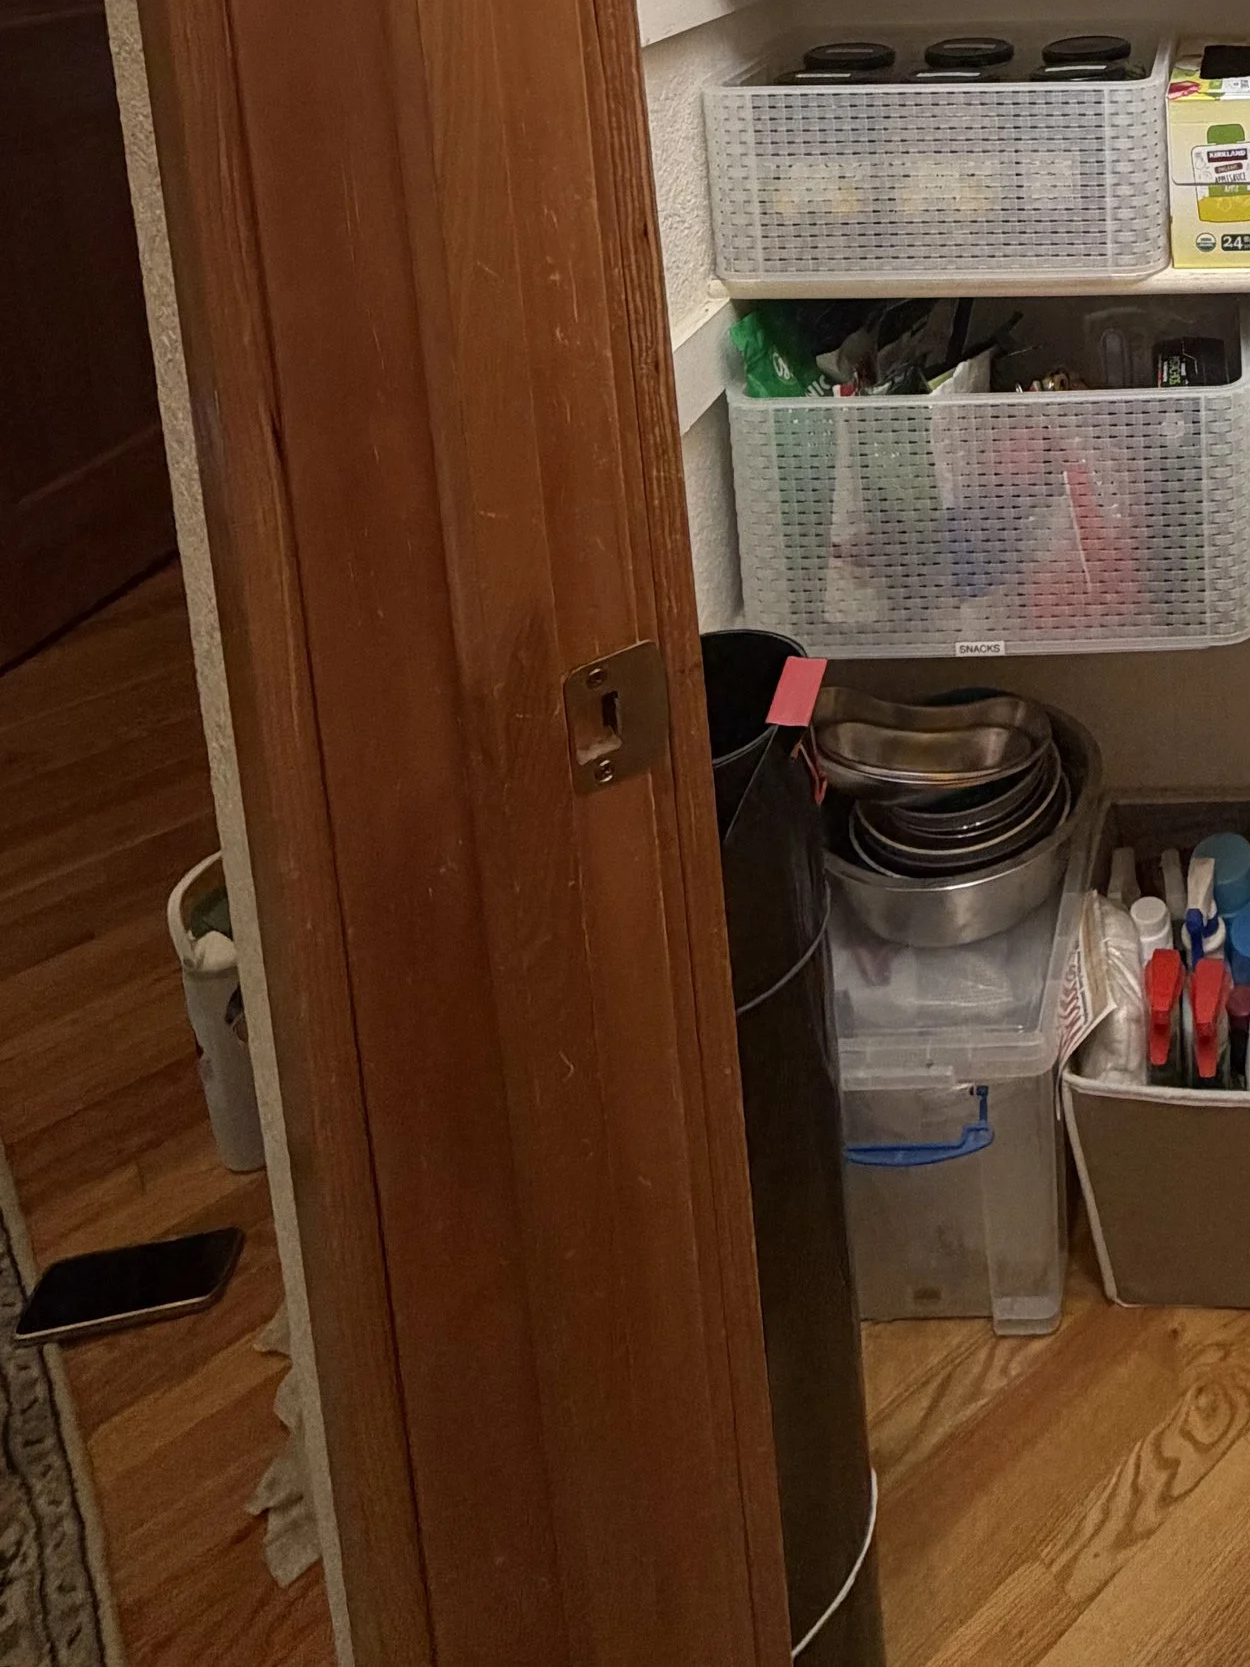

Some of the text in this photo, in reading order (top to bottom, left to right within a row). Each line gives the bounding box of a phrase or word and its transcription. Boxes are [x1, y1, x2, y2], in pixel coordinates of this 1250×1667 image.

[1208, 150, 1247, 159] KIRKLAND
[1223, 235, 1244, 250] 24
[959, 644, 1001, 654] SNACKS
